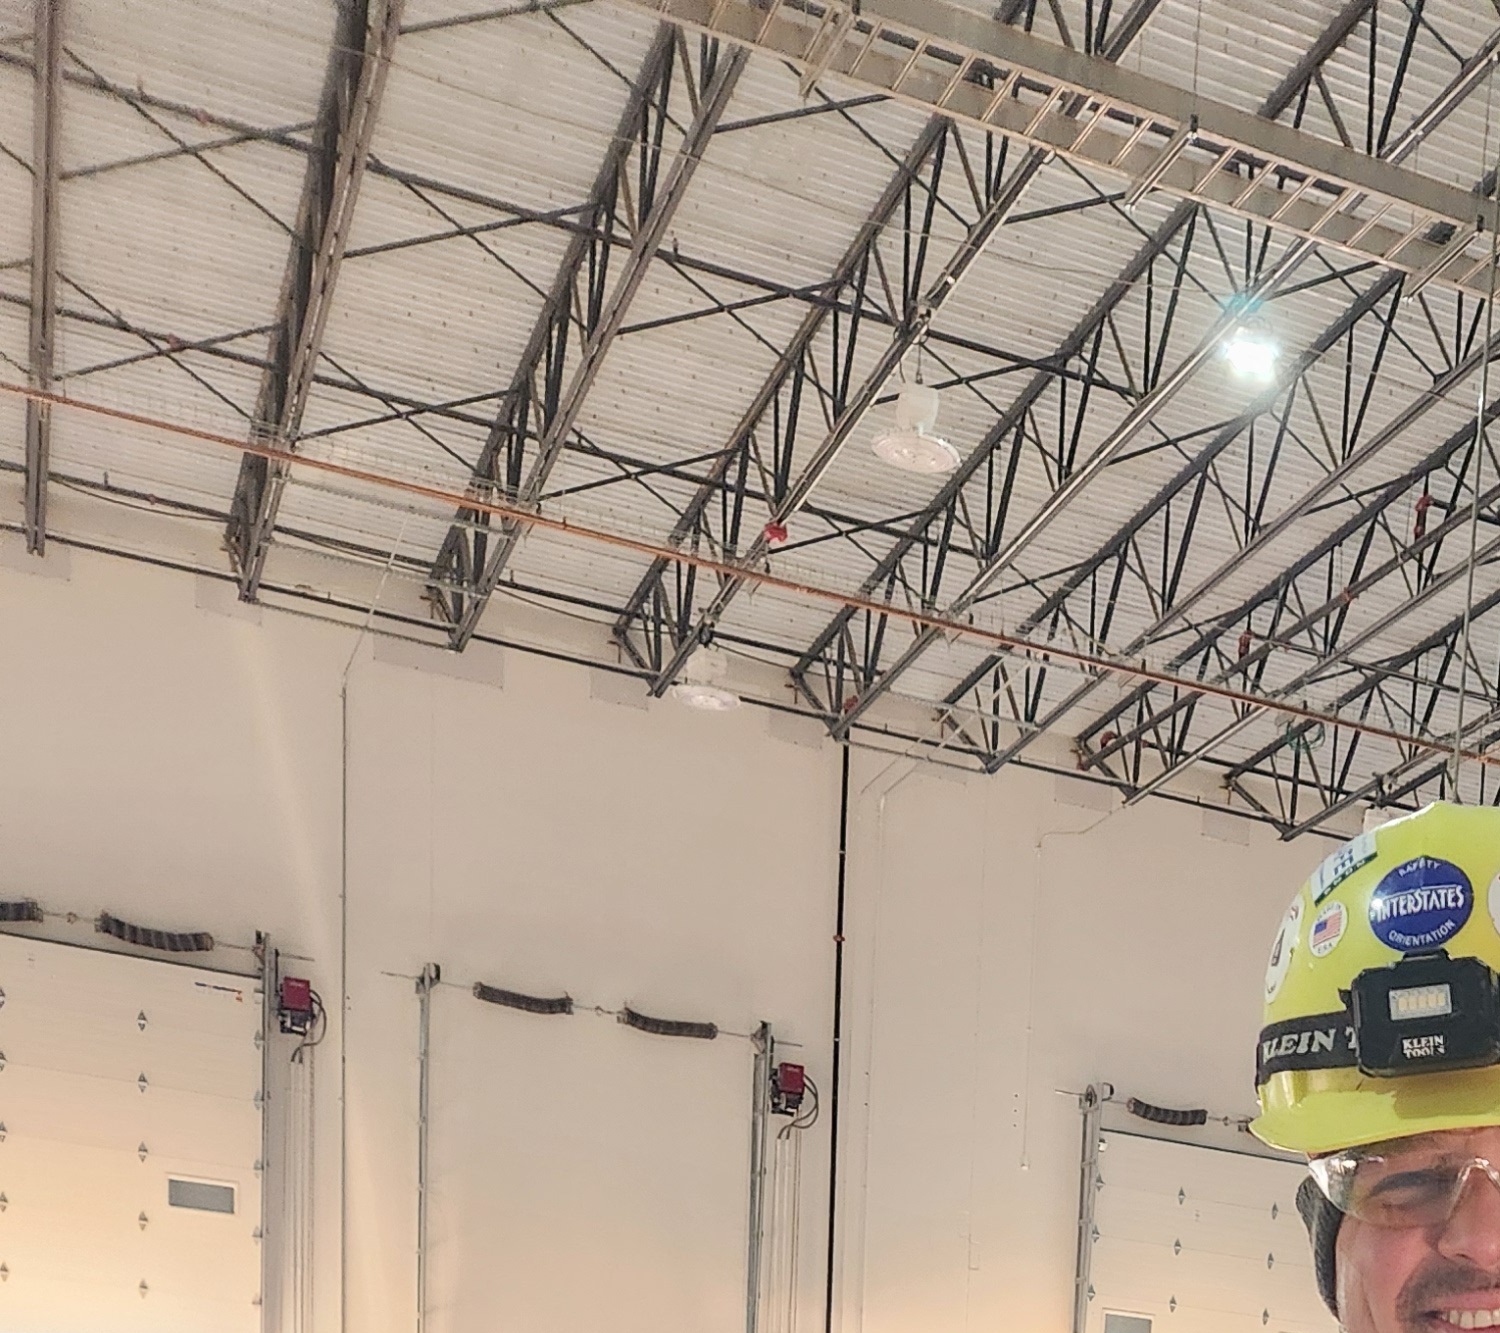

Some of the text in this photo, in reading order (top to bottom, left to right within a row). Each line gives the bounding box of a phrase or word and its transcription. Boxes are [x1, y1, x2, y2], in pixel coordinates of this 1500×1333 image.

[1376, 885, 1465, 922] INTERSTATES
[1388, 919, 1456, 946] ORIENTATION
[1402, 1034, 1444, 1050] KLEIN
